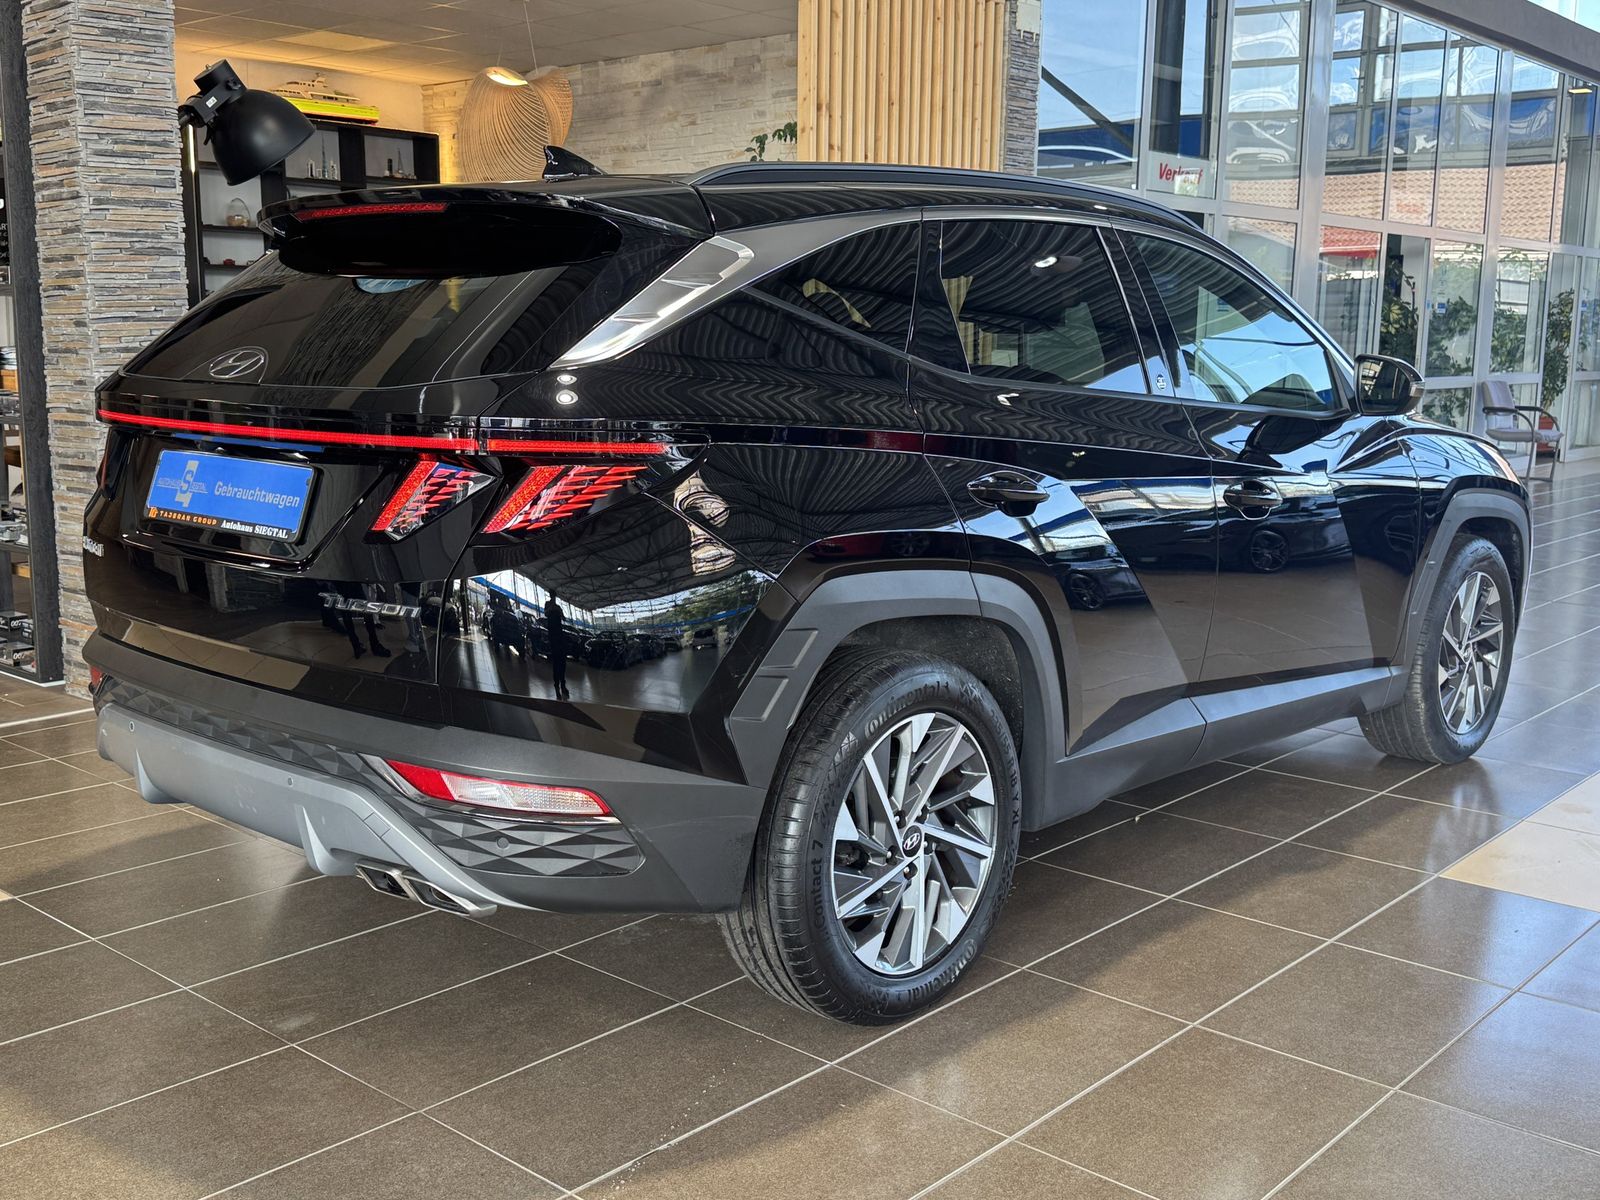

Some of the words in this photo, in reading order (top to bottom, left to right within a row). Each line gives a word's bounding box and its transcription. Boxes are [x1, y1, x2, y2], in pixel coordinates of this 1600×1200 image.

[214, 481, 300, 508] Gebrauchtwagen
[193, 516, 217, 525] GROUP
[220, 519, 253, 532] Autohaus
[254, 524, 288, 539] SIEGTAL
[318, 592, 421, 618] TUCSON
[864, 680, 941, 739] Continental
